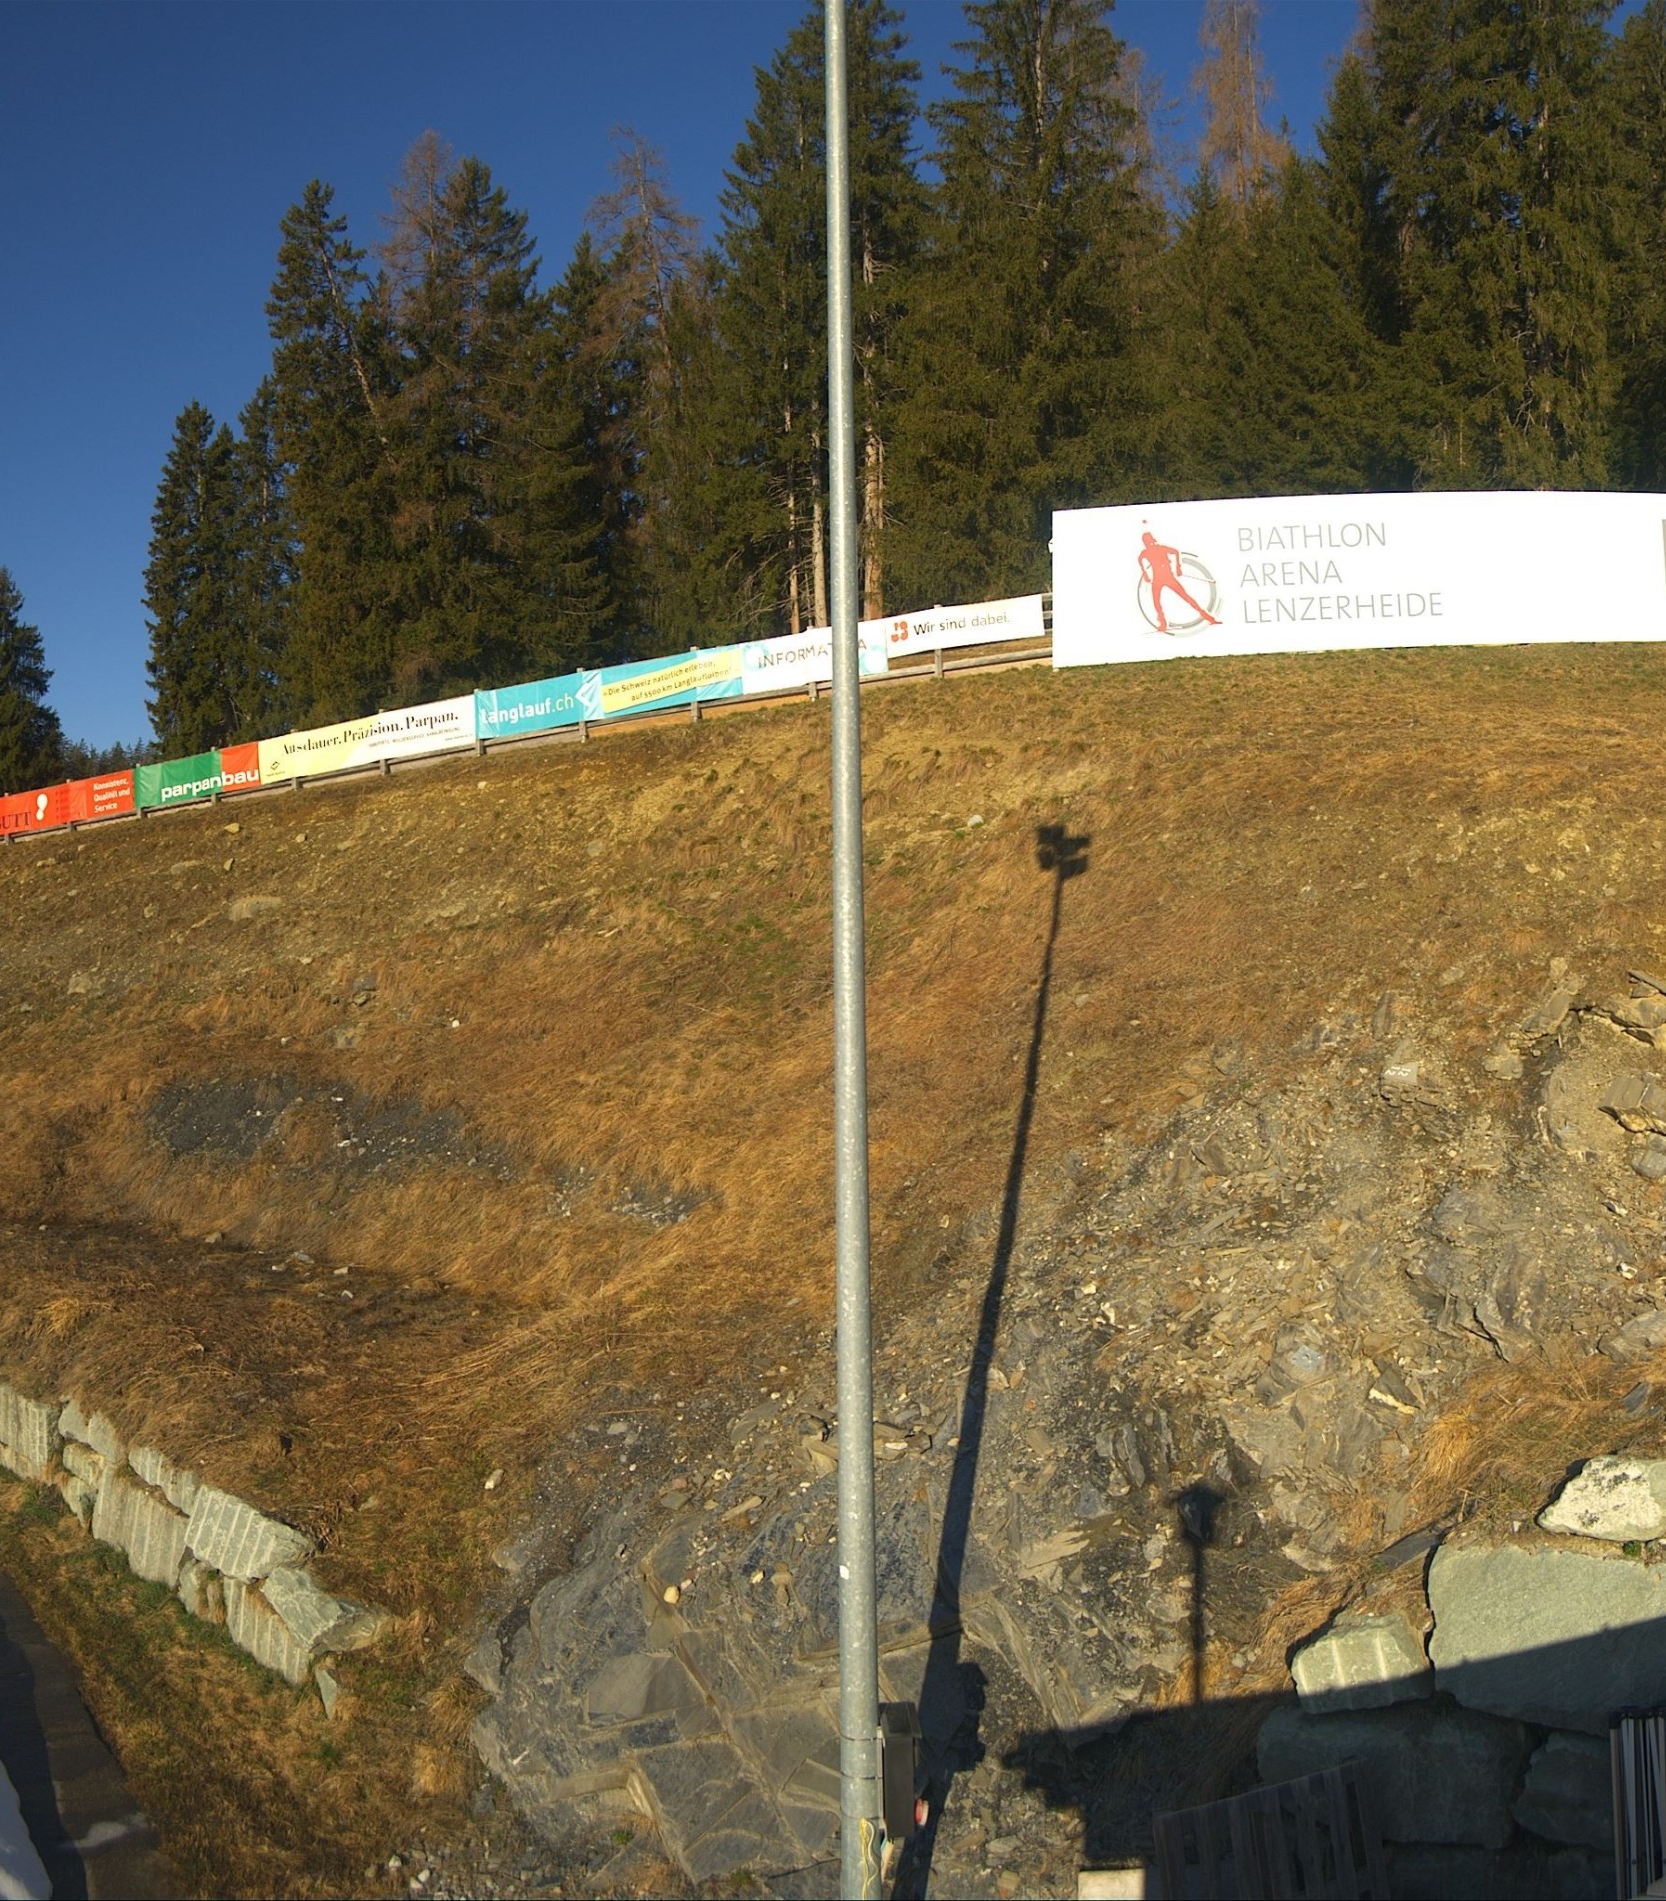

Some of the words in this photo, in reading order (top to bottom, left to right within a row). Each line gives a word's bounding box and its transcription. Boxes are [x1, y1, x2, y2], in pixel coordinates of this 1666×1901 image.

[1238, 522, 1386, 552] BIATHLON
[1240, 560, 1343, 588] ARENA
[1244, 592, 1443, 624] LENZERHEIDE
[913, 623, 935, 636] Wir
[939, 617, 966, 631] sind
[971, 612, 1011, 627] dabei.
[621, 680, 651, 692] Schweiz
[653, 669, 683, 683] natürlich
[662, 685, 673, 693] km
[481, 693, 574, 724] langlauf.ch
[282, 735, 342, 756] Ausdauer.
[343, 721, 403, 743] Präzision.
[406, 711, 459, 730] Parpan.
[118, 787, 130, 797] und
[161, 768, 259, 802] parpanbau
[94, 803, 118, 813] Service
